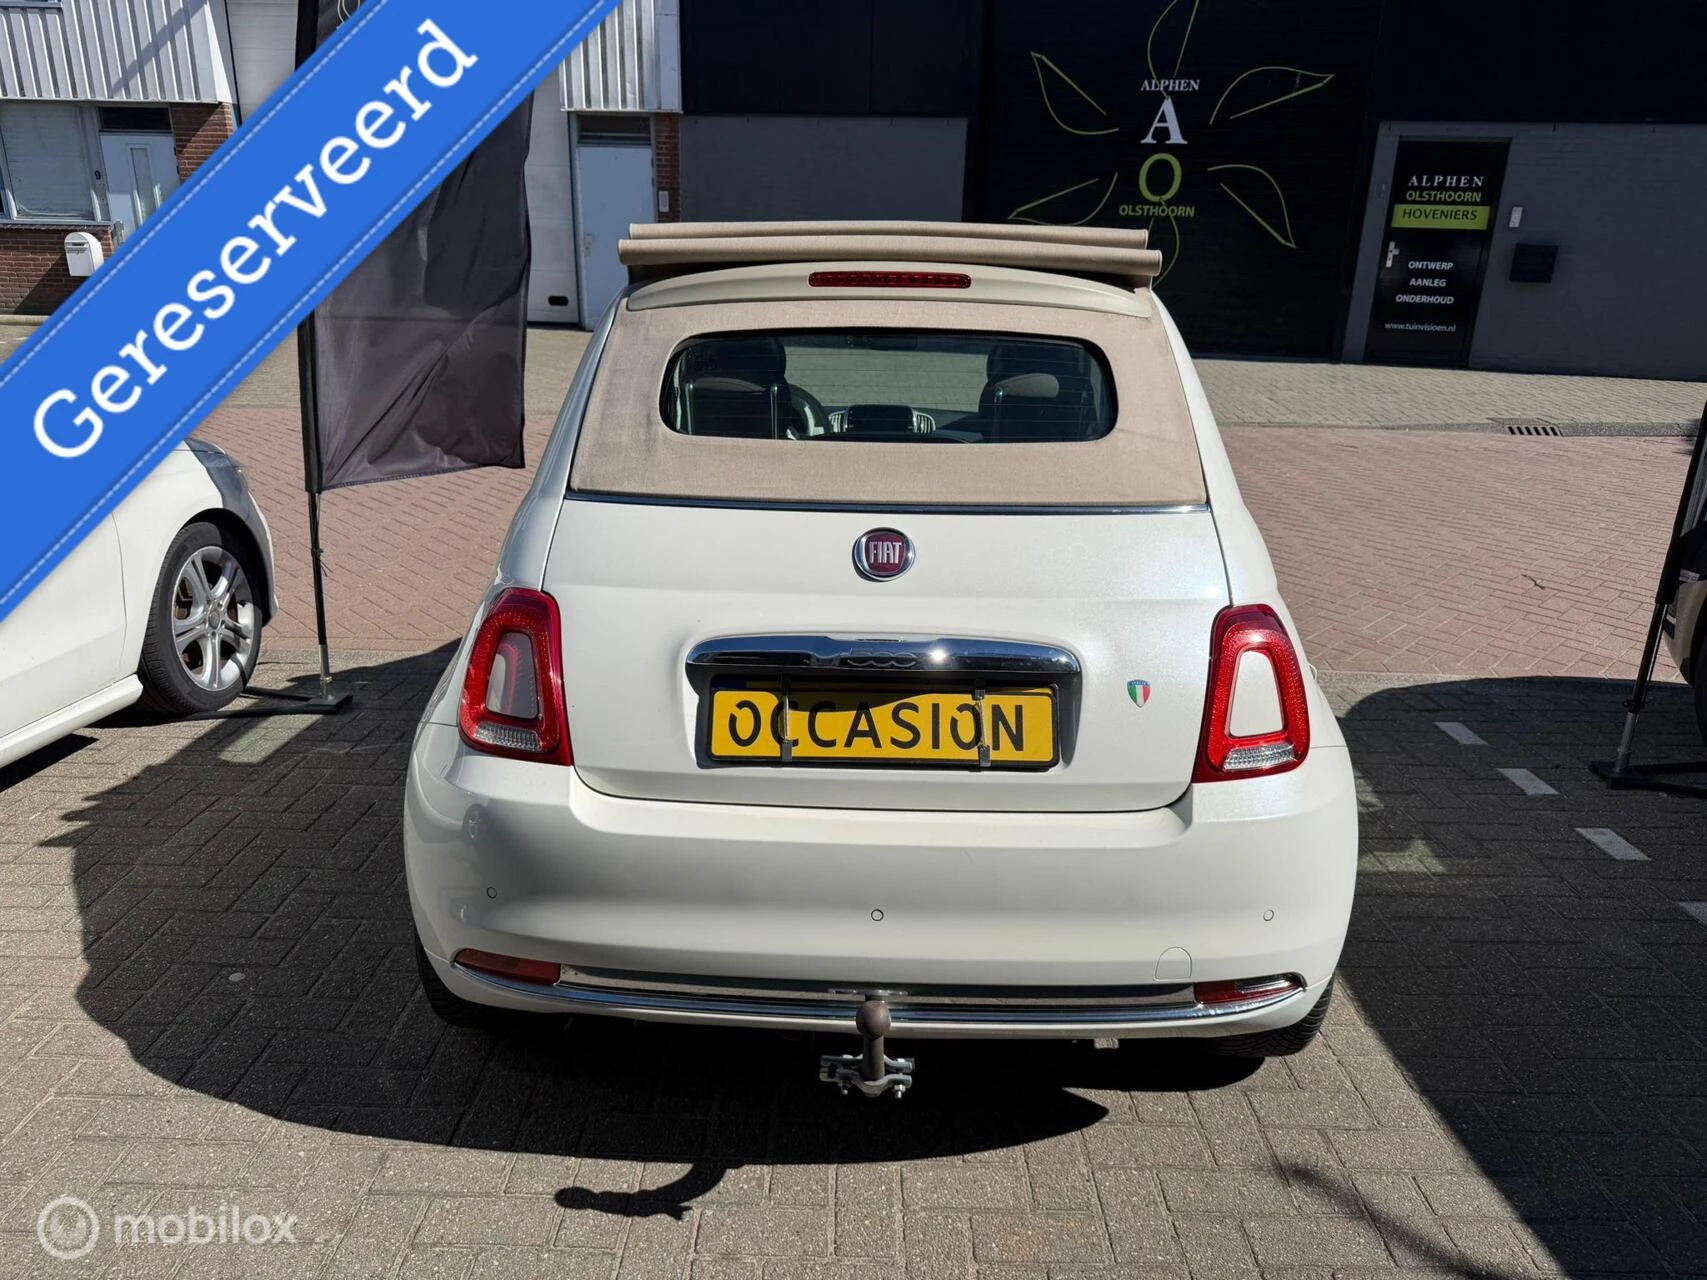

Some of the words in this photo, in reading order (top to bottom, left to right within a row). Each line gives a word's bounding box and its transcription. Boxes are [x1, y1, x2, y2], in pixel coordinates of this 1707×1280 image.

[1140, 79, 1200, 92] ALPHEN
[1140, 96, 1188, 144] A
[1138, 153, 1183, 202] O
[1408, 175, 1485, 188] ALPHEN
[1406, 190, 1482, 203] OLSTHOORN
[1118, 204, 1196, 218] OLSTHOORN
[1402, 208, 1478, 221] HOVENIERS
[1408, 261, 1454, 271] ONTWERP
[1409, 278, 1447, 288] AANLEG
[1395, 294, 1455, 305] ONDERHOUD
[869, 541, 903, 565] FIAT
[728, 699, 1025, 751] OCCASION
